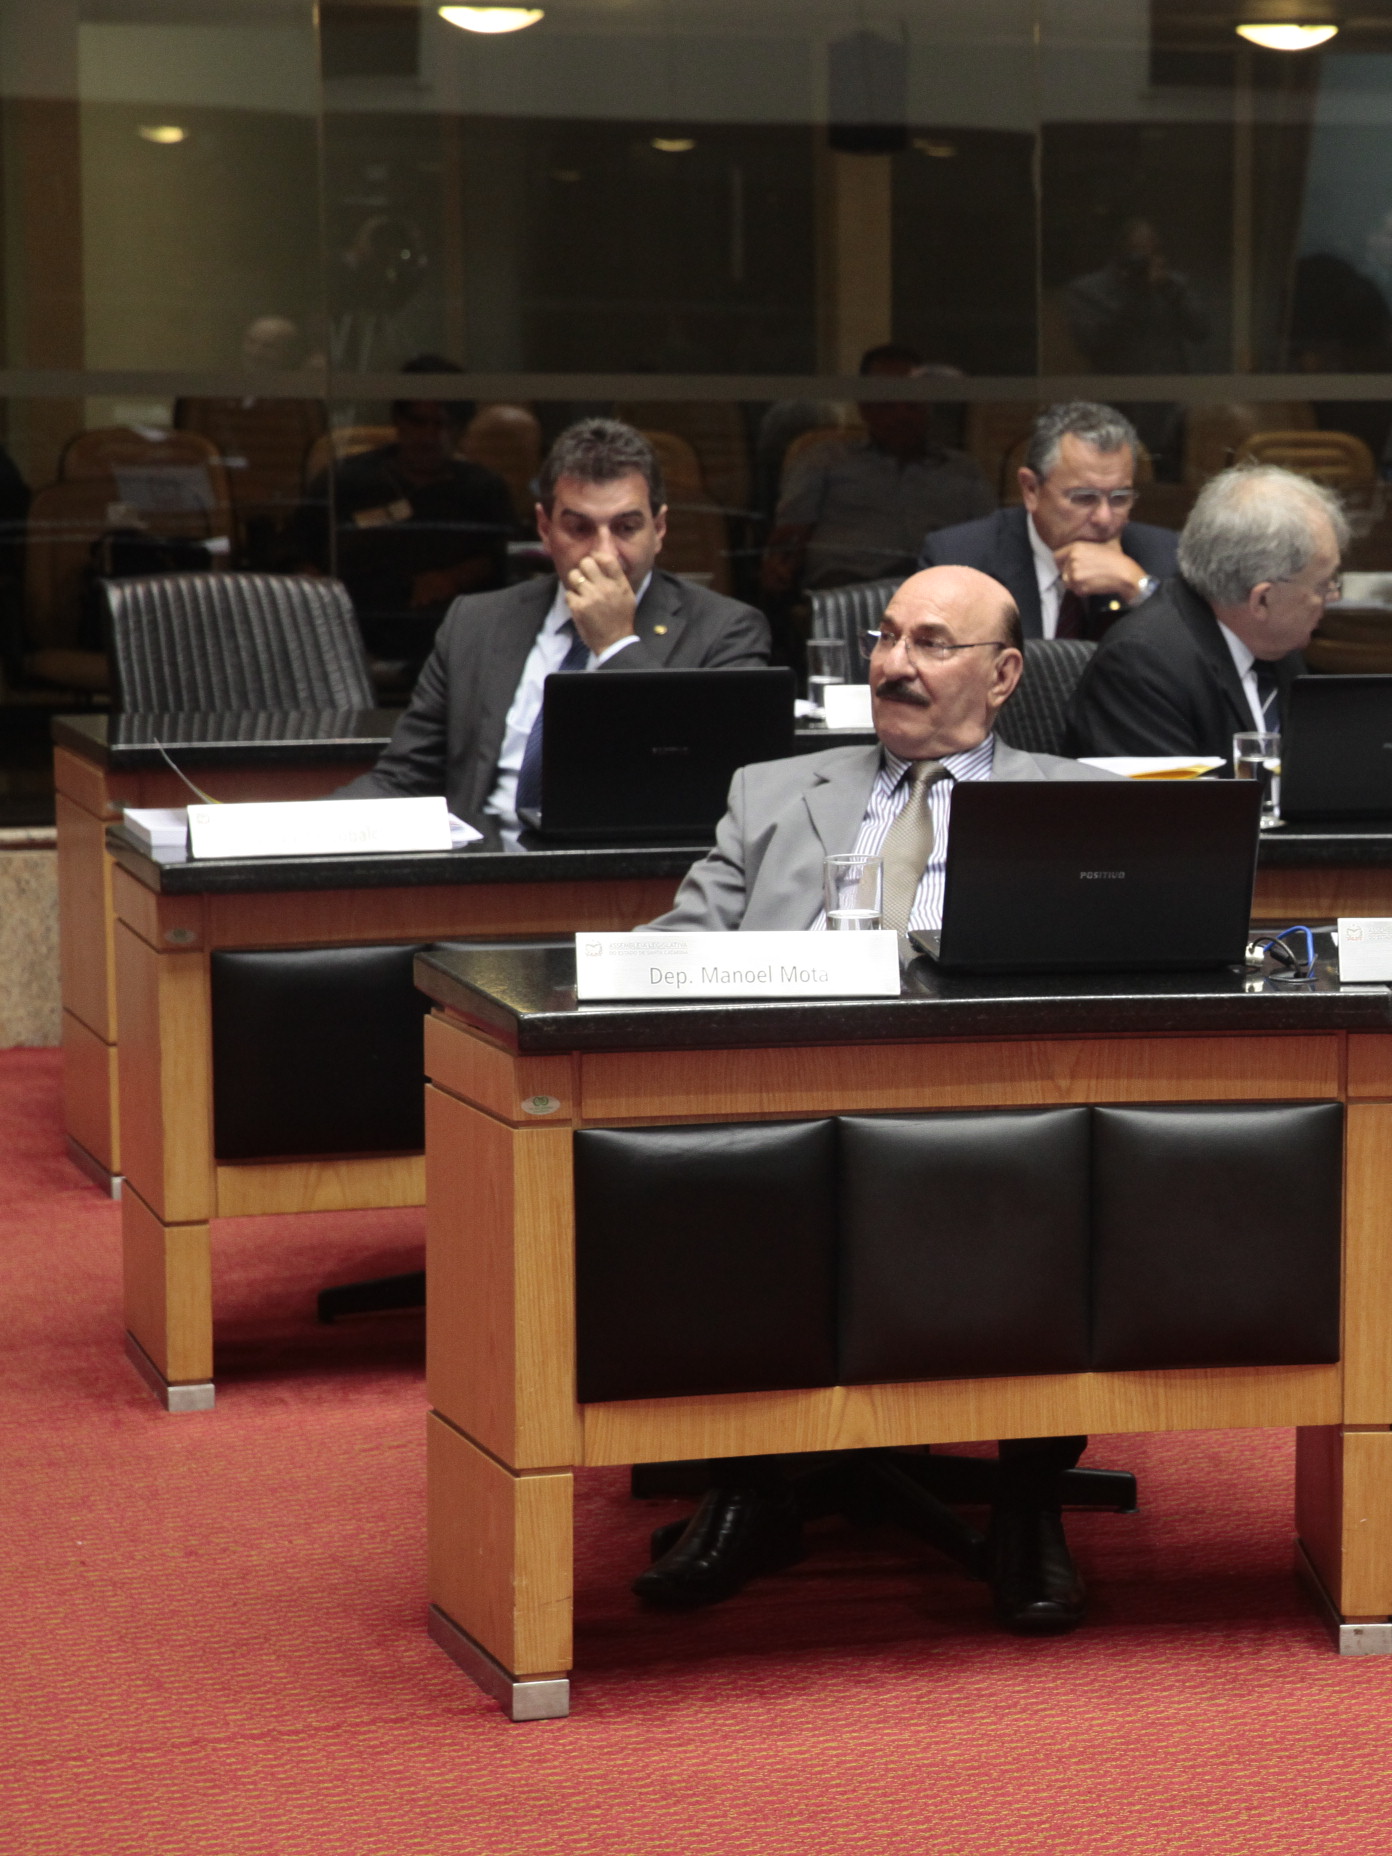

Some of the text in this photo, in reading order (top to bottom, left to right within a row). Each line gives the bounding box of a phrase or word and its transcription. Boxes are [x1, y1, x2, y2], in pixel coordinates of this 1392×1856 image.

[1080, 871, 1126, 879] POSITIVO
[650, 965, 829, 988] Dep. Manoel Mota
